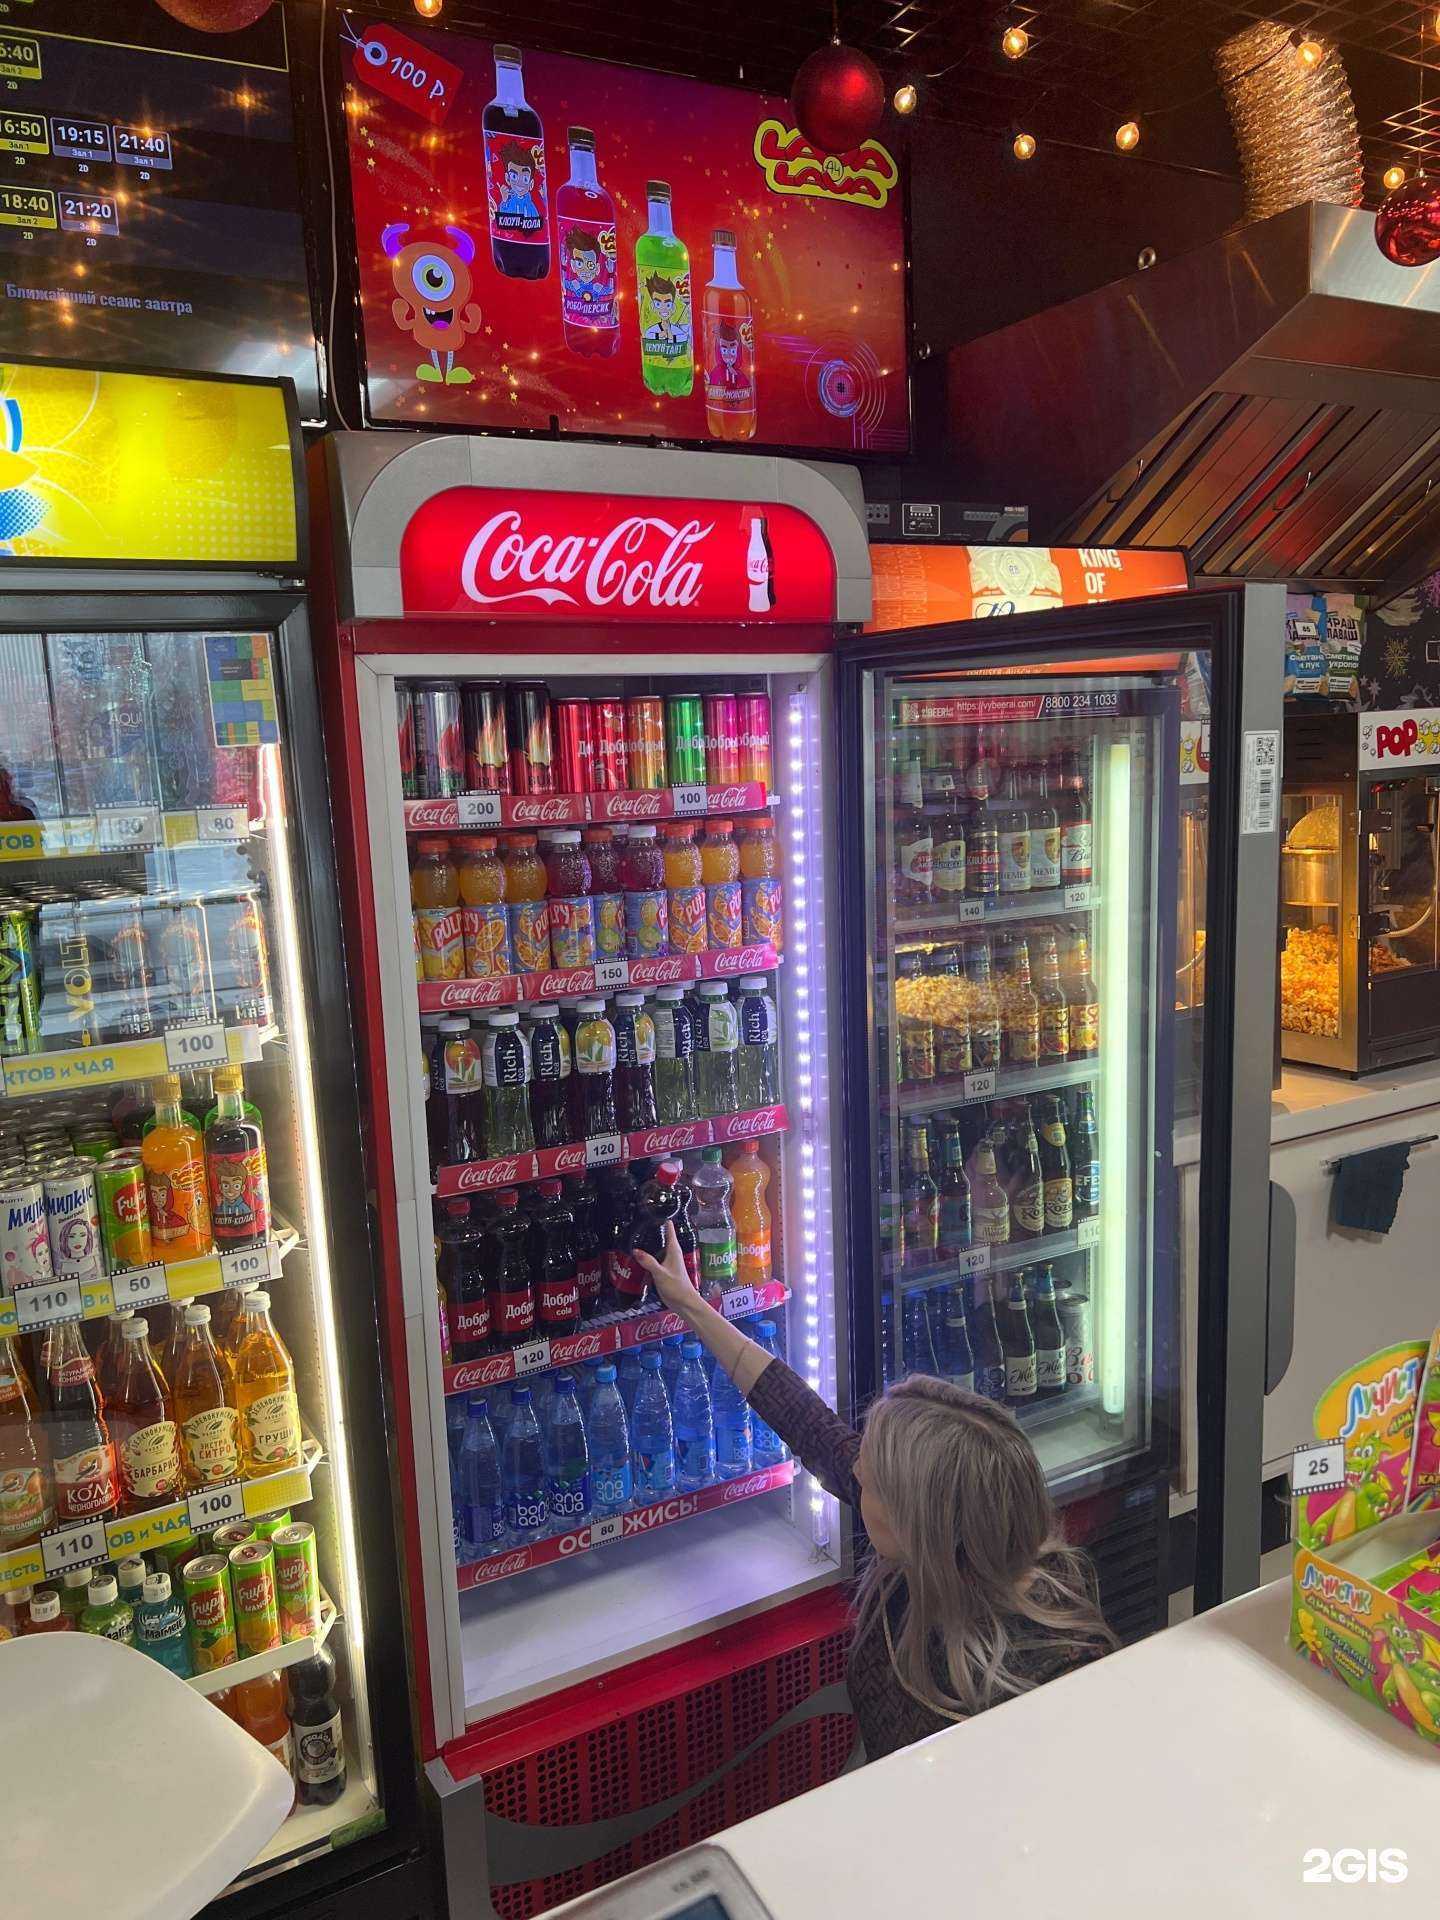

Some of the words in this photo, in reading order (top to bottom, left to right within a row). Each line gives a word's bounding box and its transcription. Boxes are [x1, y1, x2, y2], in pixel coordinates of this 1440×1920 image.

[389, 55, 427, 89] 100
[7, 80, 18, 90] 2D
[57, 125, 105, 146] 19:15
[119, 133, 165, 153] 21:40
[15, 156, 26, 165] 2D
[78, 163, 89, 173] 2D
[139, 171, 150, 180] 2D
[1, 193, 49, 211] 18:40
[64, 199, 112, 219] 21:20
[23, 231, 33, 241] 2D
[86, 237, 97, 247] 2D
[6, 283, 96, 305] Ближайший
[99, 292, 142, 310] сеанс
[144, 298, 193, 315] завтра
[461, 509, 717, 608] Coca-Cola
[1080, 548, 1121, 570] KING
[1085, 571, 1106, 595] OF
[1045, 695, 1071, 709] 8800
[1073, 694, 1091, 707] 234
[1094, 693, 1117, 707] 1033
[1376, 718, 1418, 758] POP
[679, 792, 701, 804] 100
[467, 802, 494, 815] 200
[213, 817, 234, 831] 80
[1069, 891, 1085, 902] 120
[964, 906, 980, 916] 140
[601, 967, 622, 980] 150
[749, 1010, 761, 1043] Rich
[177, 1034, 214, 1052] 100
[618, 1030, 629, 1063] Rich
[503, 1047, 517, 1084] Rich
[540, 1040, 554, 1077] Rich
[60, 1068, 71, 1079] и
[73, 1056, 115, 1076] ЧАЯ
[970, 1079, 990, 1091] 120
[592, 1143, 615, 1156] 120
[554, 1149, 587, 1172] Coca-
[229, 1257, 260, 1273] 100
[965, 1254, 985, 1267] 120
[129, 1276, 151, 1292] 50
[28, 1291, 69, 1312] 110
[729, 1295, 749, 1309] 120
[555, 1306, 573, 1317] cola
[521, 1349, 544, 1365] 120
[199, 1445, 232, 1459] СИТРО
[1308, 1458, 1329, 1476] 25
[67, 1480, 115, 1504] КОЛА
[199, 1494, 232, 1514] 100
[138, 1530, 149, 1540] и
[153, 1513, 190, 1535] ЧАЯ
[600, 1523, 615, 1535] 80
[56, 1534, 94, 1557] 110
